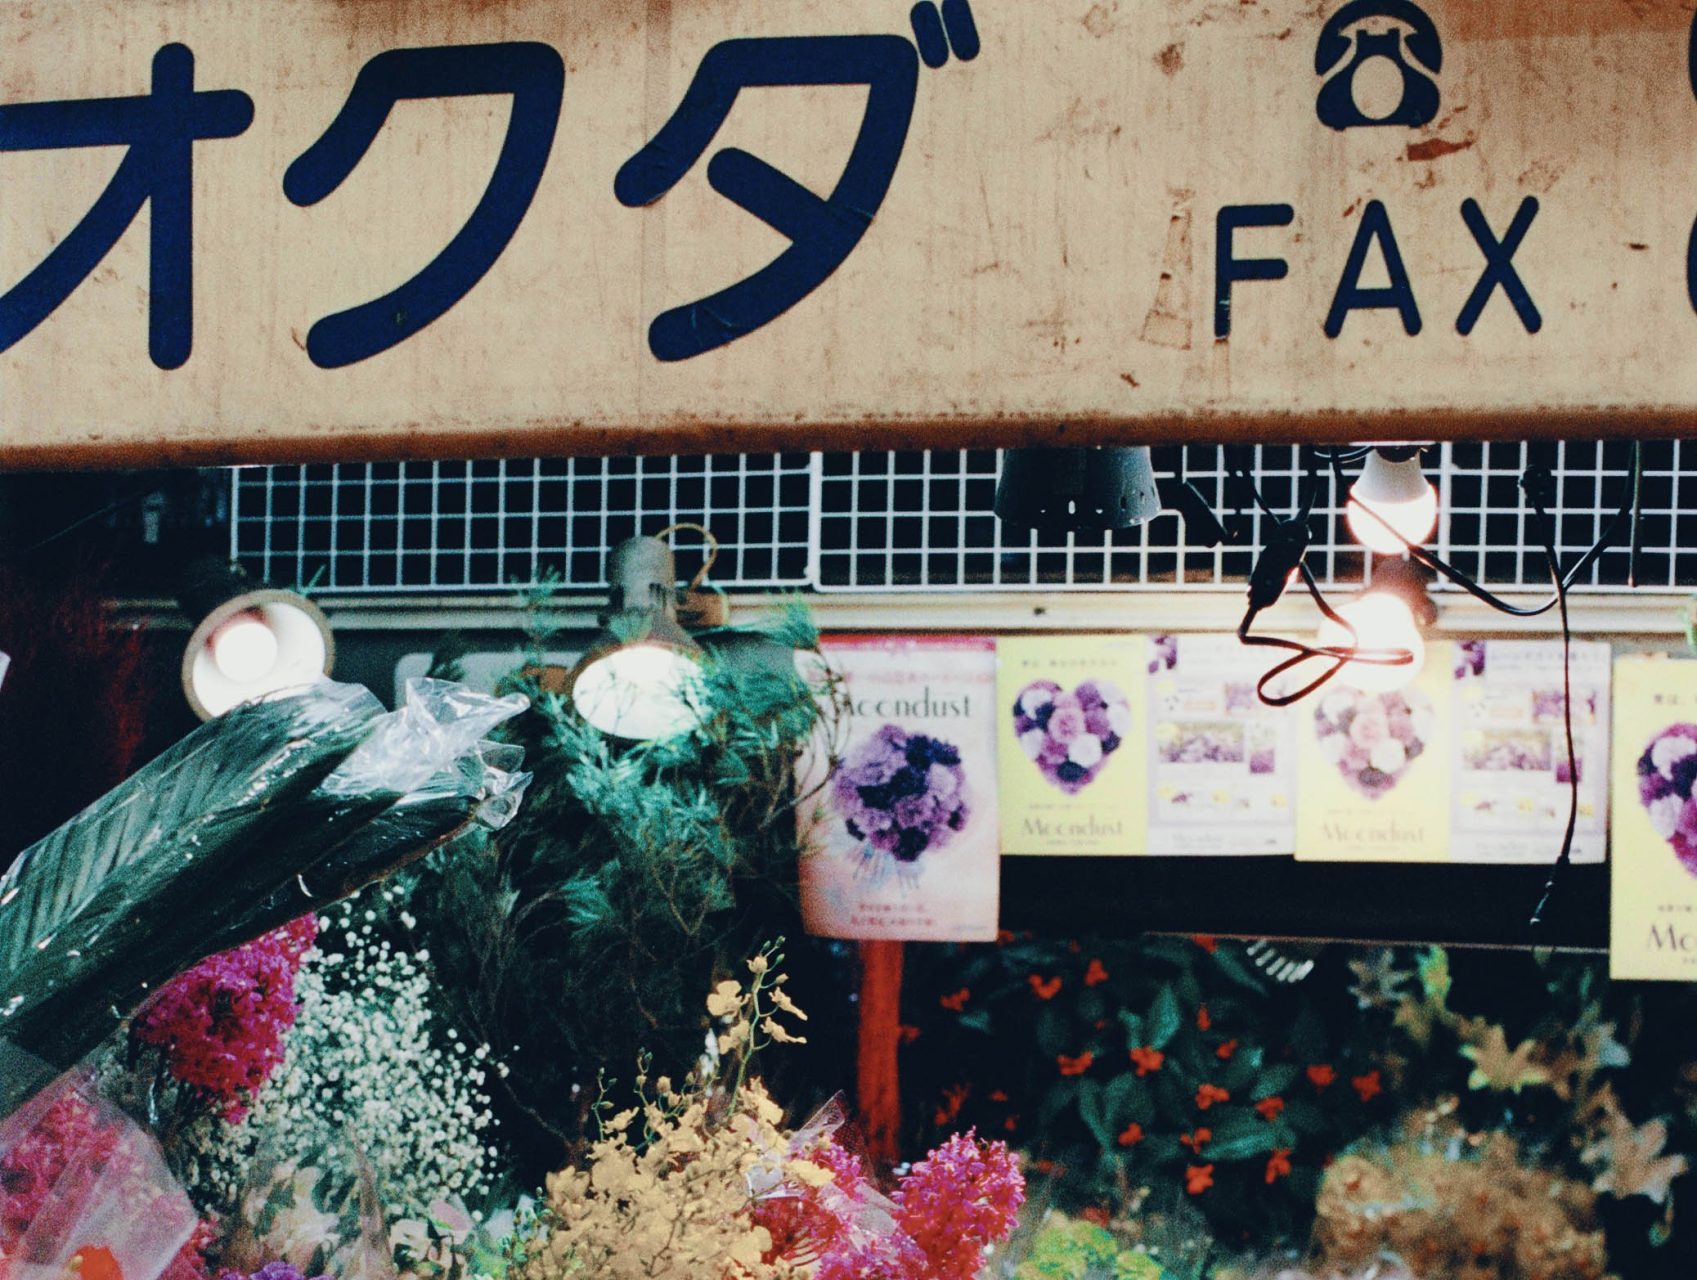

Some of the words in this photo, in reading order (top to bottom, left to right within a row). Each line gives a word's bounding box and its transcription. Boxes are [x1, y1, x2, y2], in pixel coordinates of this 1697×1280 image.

[0, 0, 981, 370] オクダ
[1214, 195, 1543, 339] FAX
